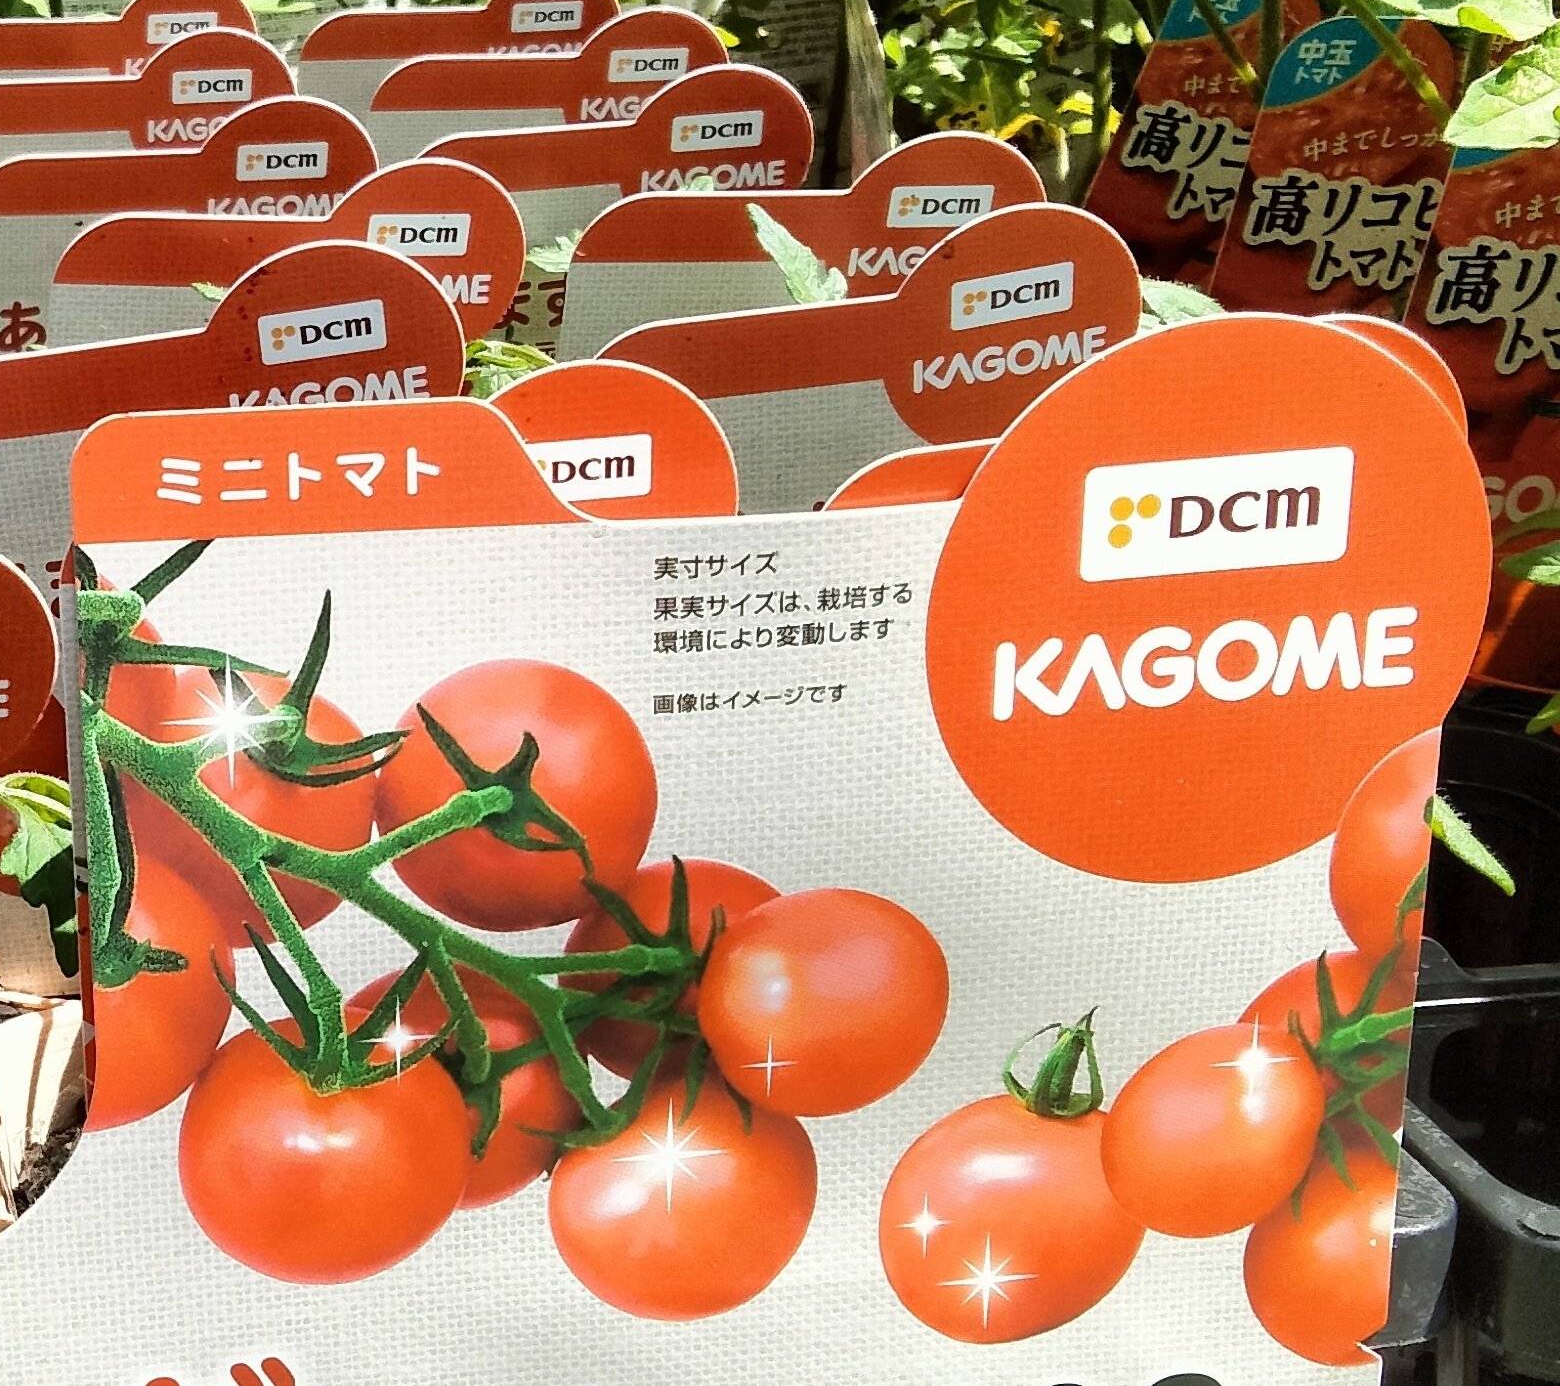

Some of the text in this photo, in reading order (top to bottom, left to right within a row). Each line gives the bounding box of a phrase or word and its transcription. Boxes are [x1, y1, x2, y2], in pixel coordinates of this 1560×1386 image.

[1297, 38, 1358, 67] 中玉
[1294, 65, 1344, 86] トマト
[1303, 126, 1445, 163] 中までしっか
[1175, 173, 1237, 214] トマ
[913, 325, 1108, 394] KAGOME
[155, 446, 443, 506] ミニトマト
[653, 549, 779, 580] 実寸サイズ
[653, 581, 915, 622] 果実サイズは、栽培する
[652, 617, 895, 654] 環境により変動します
[992, 605, 1419, 723] KAGOME
[652, 683, 848, 716] 画像はイメージです
